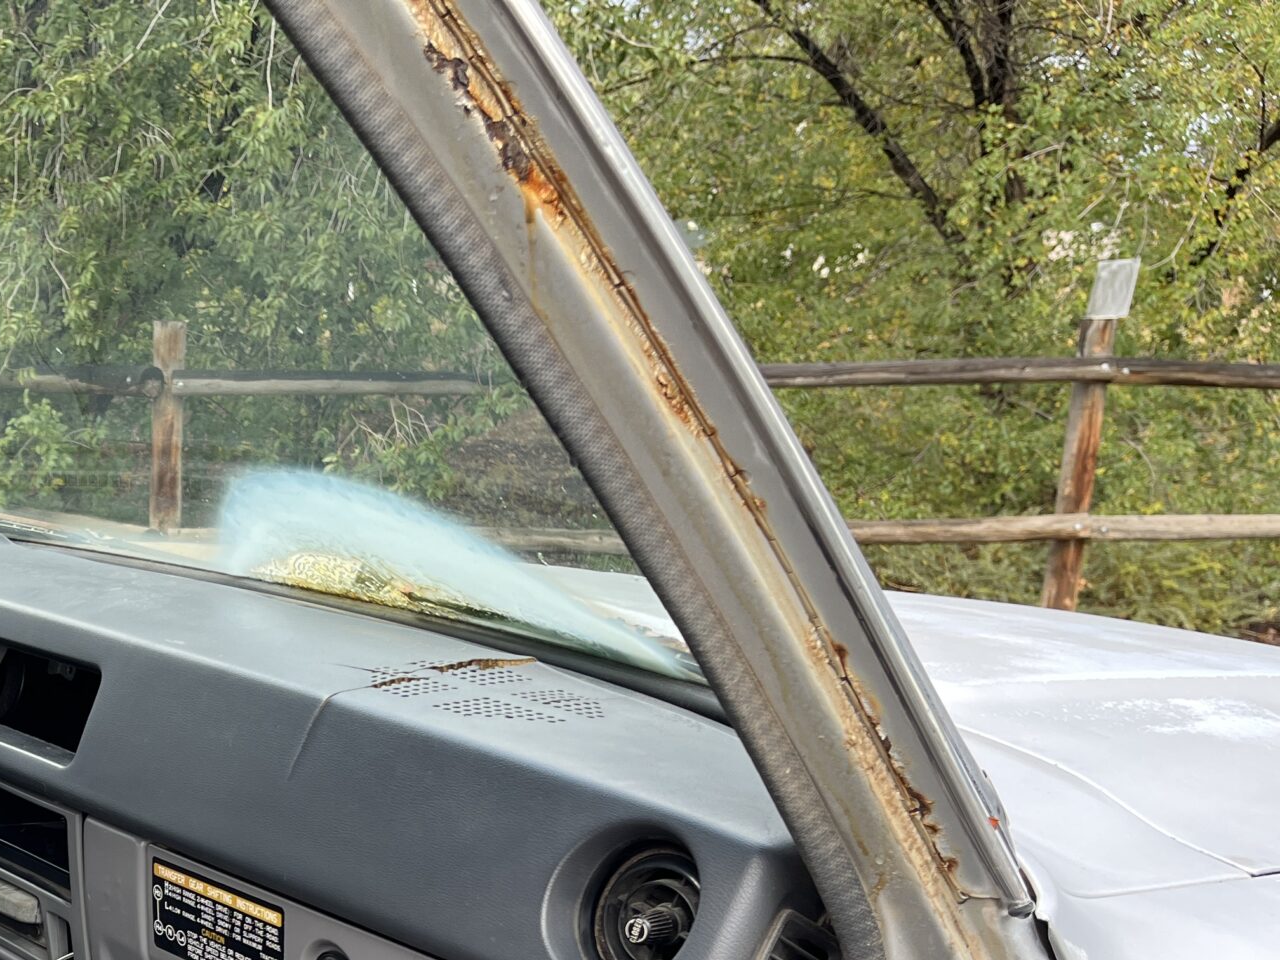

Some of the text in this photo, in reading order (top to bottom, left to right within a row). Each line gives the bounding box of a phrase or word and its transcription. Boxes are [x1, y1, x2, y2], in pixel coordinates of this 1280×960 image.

[158, 866, 277, 924] TRANSFER GEAR SHIFTING INSTRUCTIONS
[201, 927, 224, 945] CAUTION
[628, 918, 644, 944] CLOSED
[187, 930, 198, 940] STOP
[199, 935, 208, 945] THE
[209, 940, 226, 953] VEHICLE
[227, 948, 234, 957] OR
[187, 937, 204, 950] VEHICLE
[205, 945, 219, 957] SPEED
[187, 944, 203, 957] BEFORE
[187, 950, 199, 960] FROM
